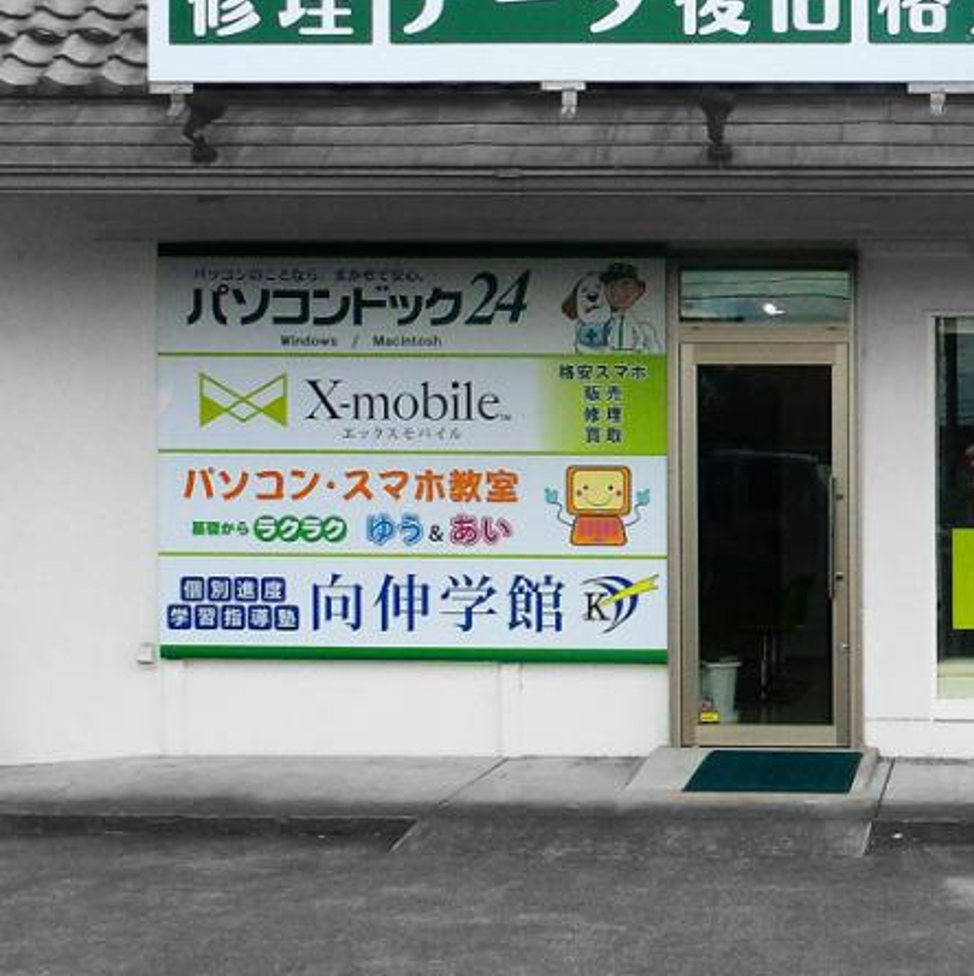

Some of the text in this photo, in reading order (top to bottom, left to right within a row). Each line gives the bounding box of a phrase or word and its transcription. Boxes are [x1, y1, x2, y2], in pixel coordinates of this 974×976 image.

[280, 335, 338, 347] Windows
[373, 335, 442, 347] Macintosh
[559, 365, 646, 380] 格安スマホ
[305, 379, 500, 421] X-mobile
[584, 406, 621, 423] 修理
[341, 427, 461, 440] エックスモバイル
[184, 468, 519, 503] パソコン・スマホ教室
[367, 513, 423, 545] ゆう
[450, 513, 513, 545] あい
[312, 573, 565, 633] 向伸学館
[169, 606, 299, 629] 学習指導塾
